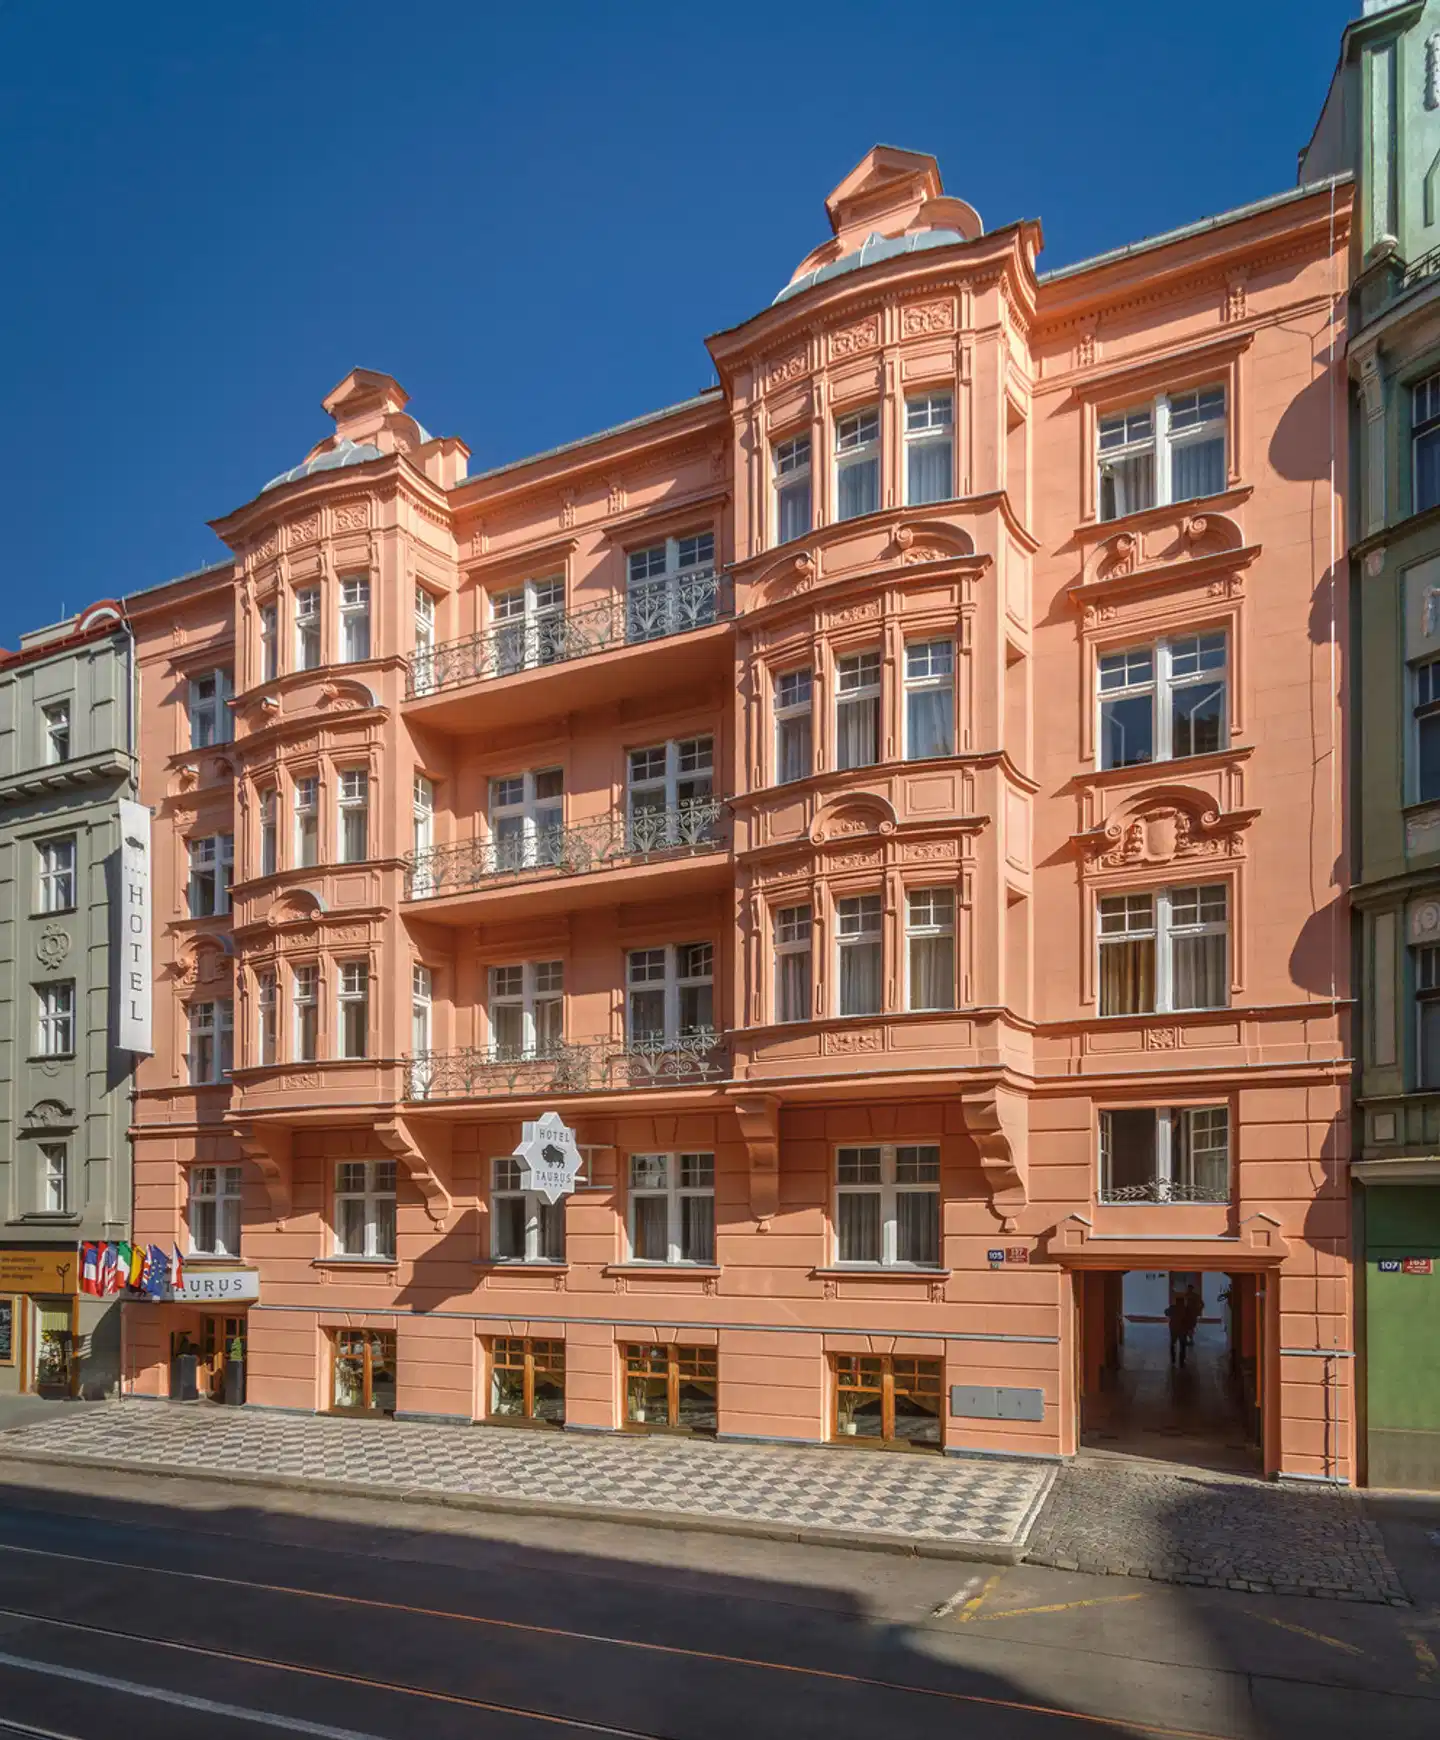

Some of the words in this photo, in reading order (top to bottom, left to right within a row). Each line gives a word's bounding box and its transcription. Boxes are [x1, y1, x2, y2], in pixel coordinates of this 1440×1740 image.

[128, 884, 144, 1022] HOTEL
[539, 1129, 570, 1142] HOTEL
[536, 1171, 571, 1183] TAURUS
[1380, 1261, 1398, 1270] 107
[164, 1279, 243, 1292] TURUS
